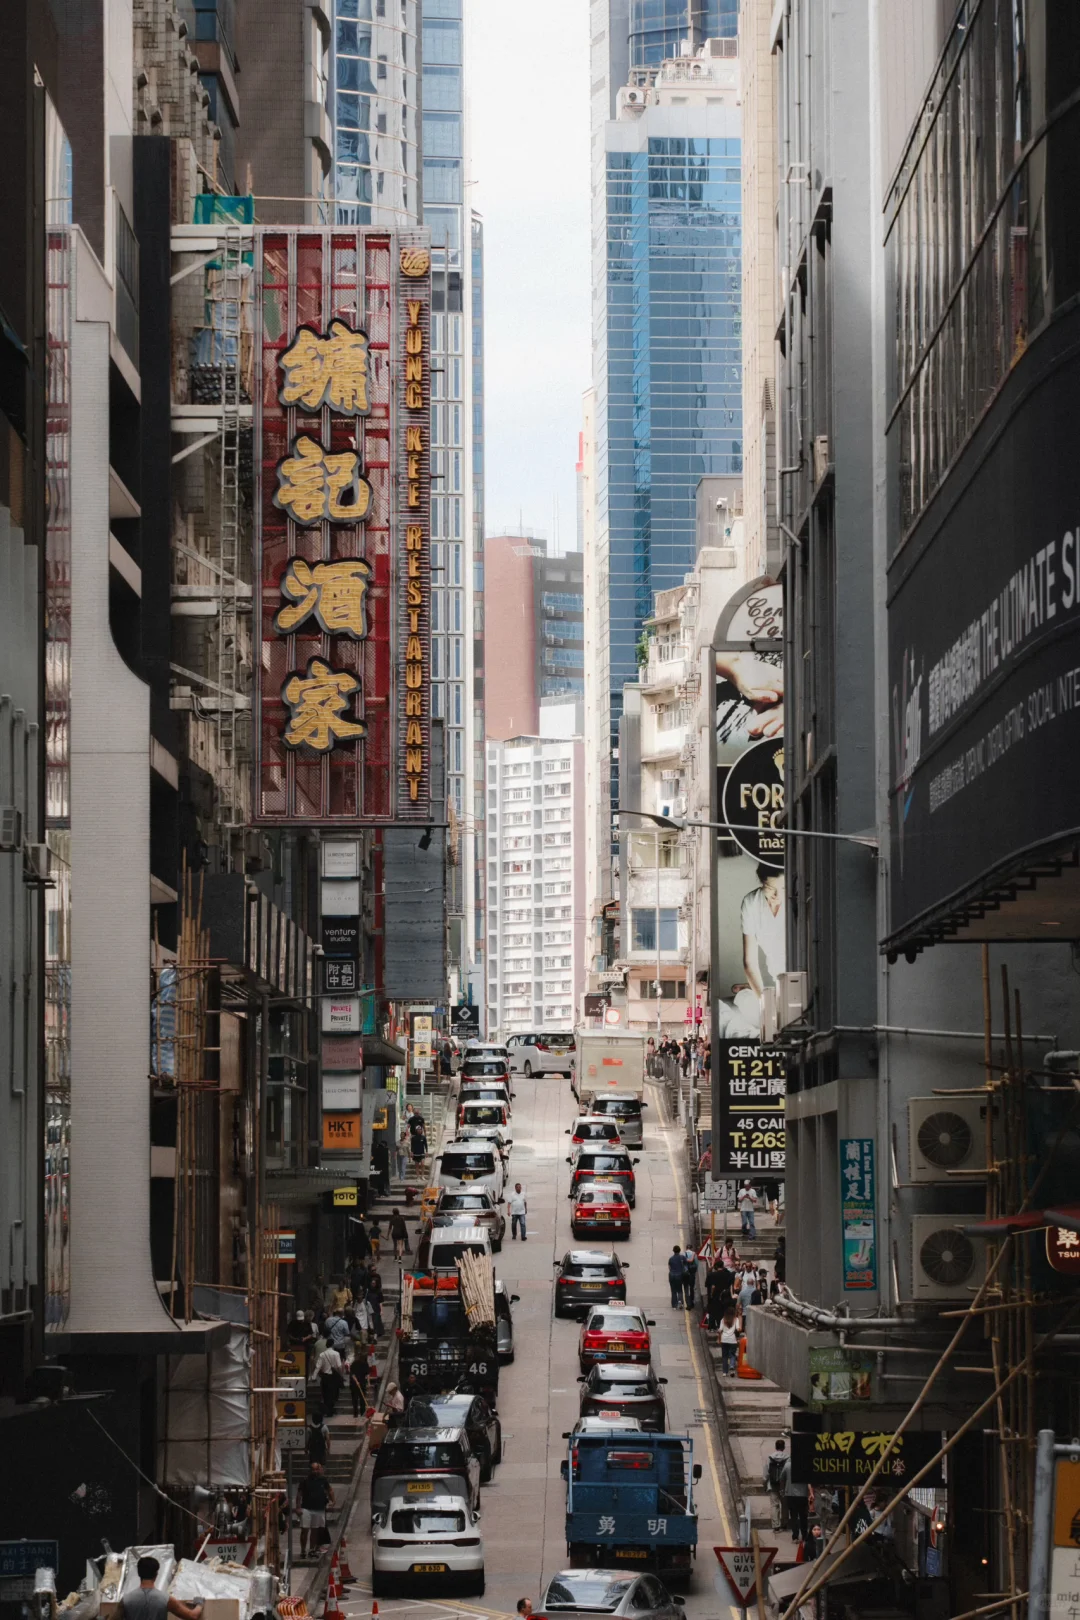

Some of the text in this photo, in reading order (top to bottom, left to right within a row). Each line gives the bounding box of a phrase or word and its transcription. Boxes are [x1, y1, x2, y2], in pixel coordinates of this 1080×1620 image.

[278, 321, 370, 750] 鏞記酒家
[405, 301, 422, 801] YUNG KEE RESTAURANT
[981, 597, 999, 680] THE
[1000, 540, 1056, 660] ULTIMATE
[324, 928, 357, 936] venture
[729, 1060, 746, 1076] T:
[328, 1121, 354, 1131] HKT
[737, 1118, 754, 1129] 45
[729, 1132, 785, 1148] T: 263
[411, 1363, 428, 1376] 68
[469, 1362, 487, 1375] 46
[812, 1458, 850, 1473] SUSHI
[596, 1516, 667, 1536] 勇 明
[19, 1547, 53, 1555] STAND
[733, 1555, 756, 1563] GIVE
[733, 1564, 756, 1573] WAY
[1057, 1592, 1080, 1602] mid
